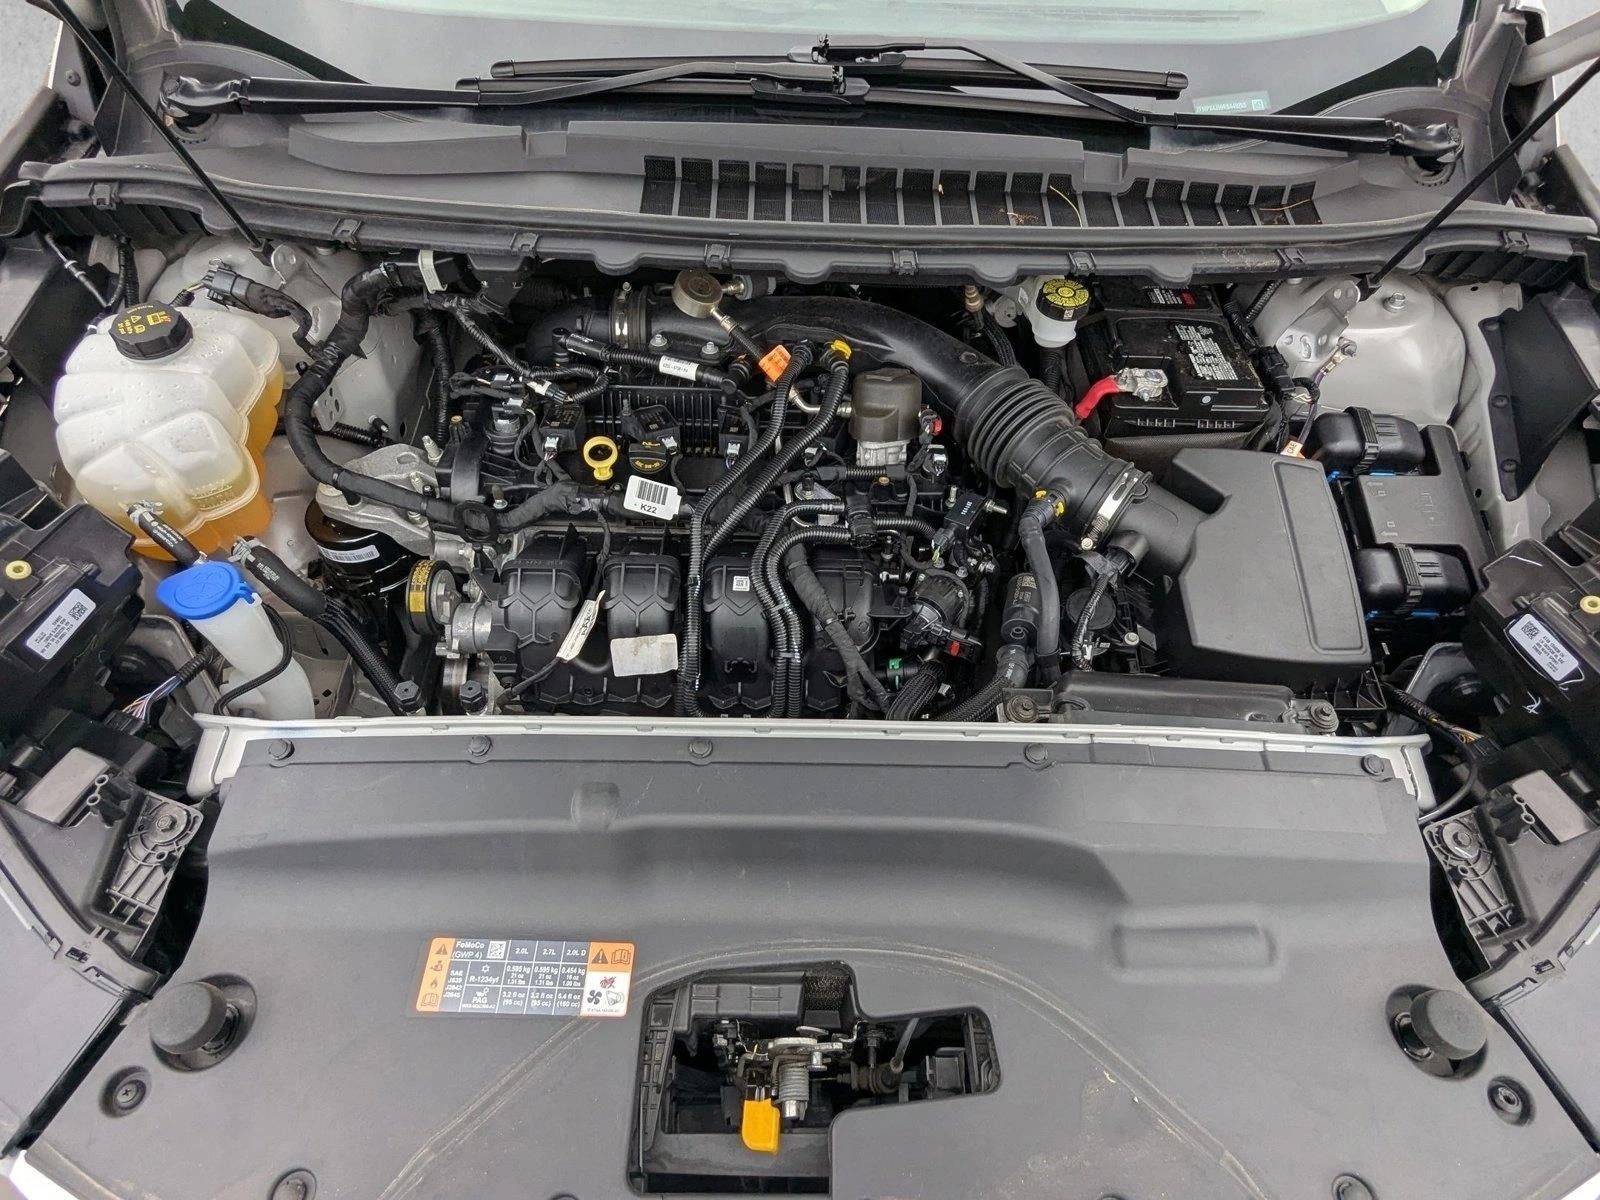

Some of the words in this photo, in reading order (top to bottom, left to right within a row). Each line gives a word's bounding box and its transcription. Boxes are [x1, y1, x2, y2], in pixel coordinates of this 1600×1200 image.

[640, 503, 657, 514] K22
[455, 941, 485, 949] FoMoCo
[452, 950, 474, 960] (GWP
[474, 952, 483, 960] 4)
[523, 966, 531, 974] kg
[551, 967, 559, 975] kg
[578, 967, 586, 976] kg
[469, 976, 499, 984] R-1234yf
